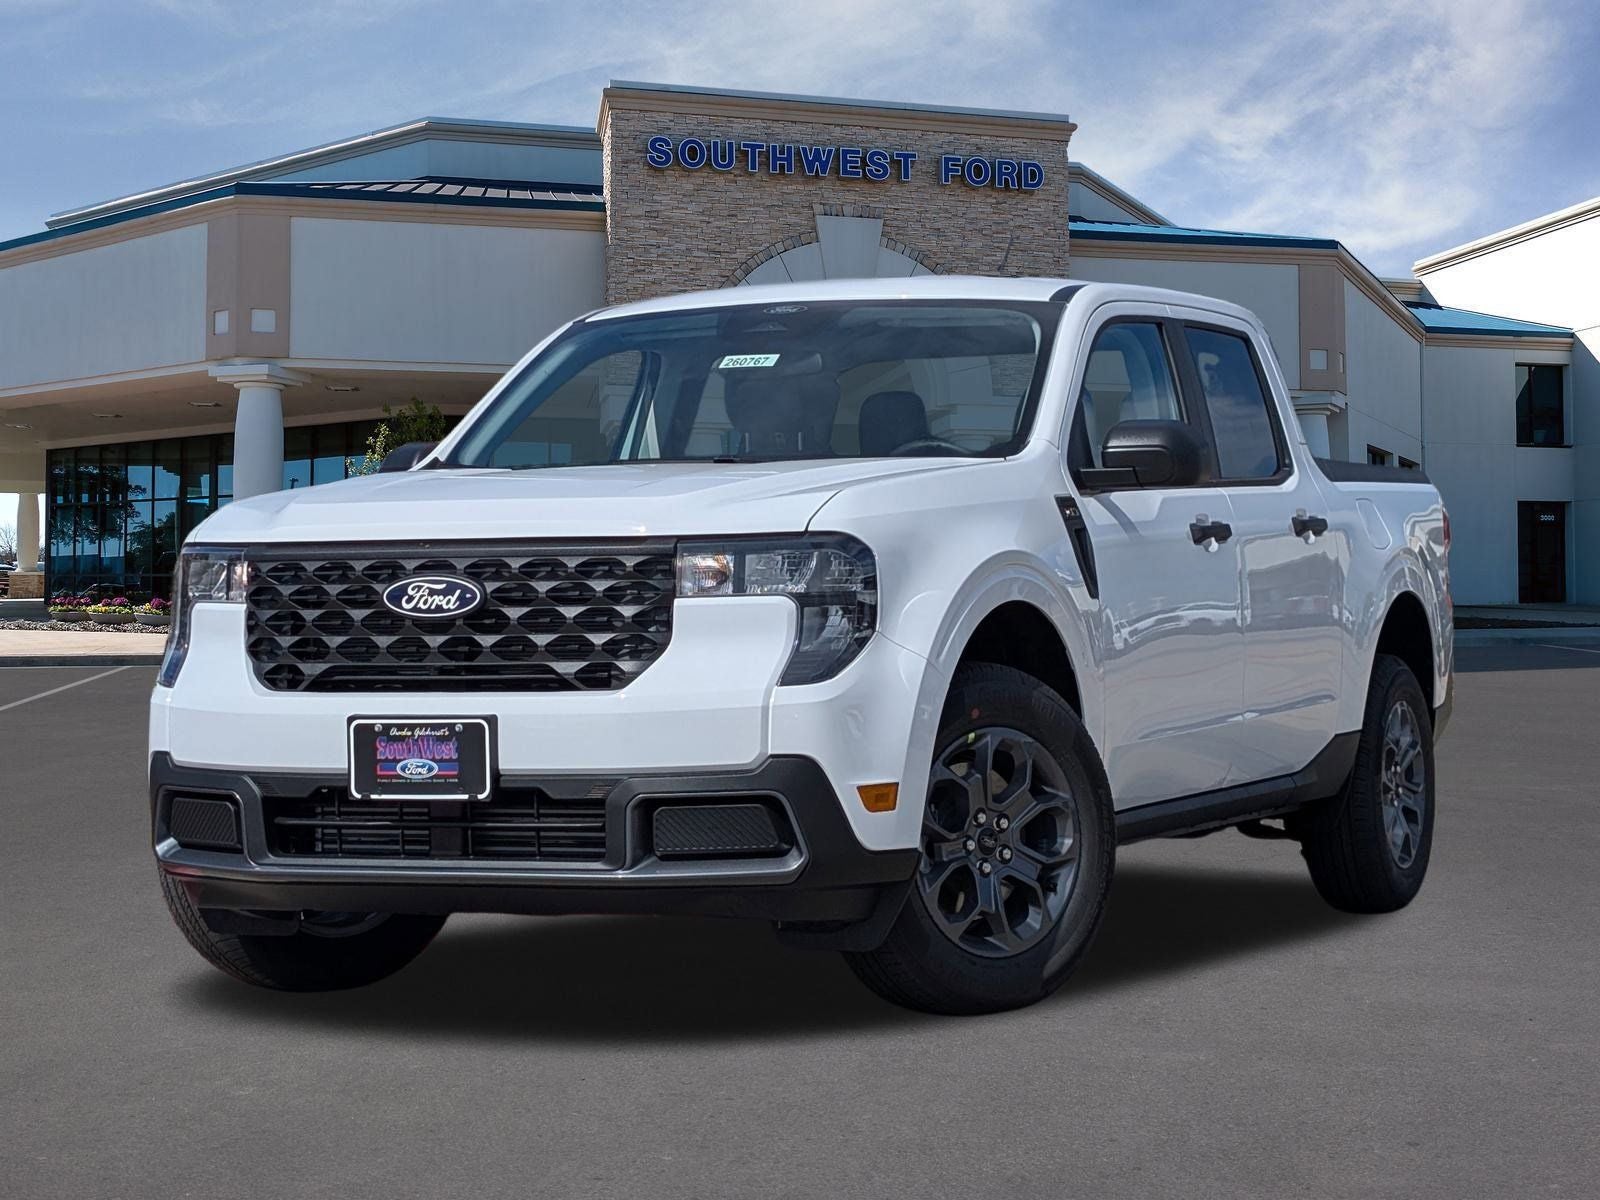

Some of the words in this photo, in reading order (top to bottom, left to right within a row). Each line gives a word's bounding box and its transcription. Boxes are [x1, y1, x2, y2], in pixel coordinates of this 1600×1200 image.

[646, 135, 918, 182] SOUTHWEST
[938, 154, 1045, 190] FORD
[723, 356, 770, 367] 260767
[401, 582, 462, 610] Ford
[405, 761, 429, 775] Ford
